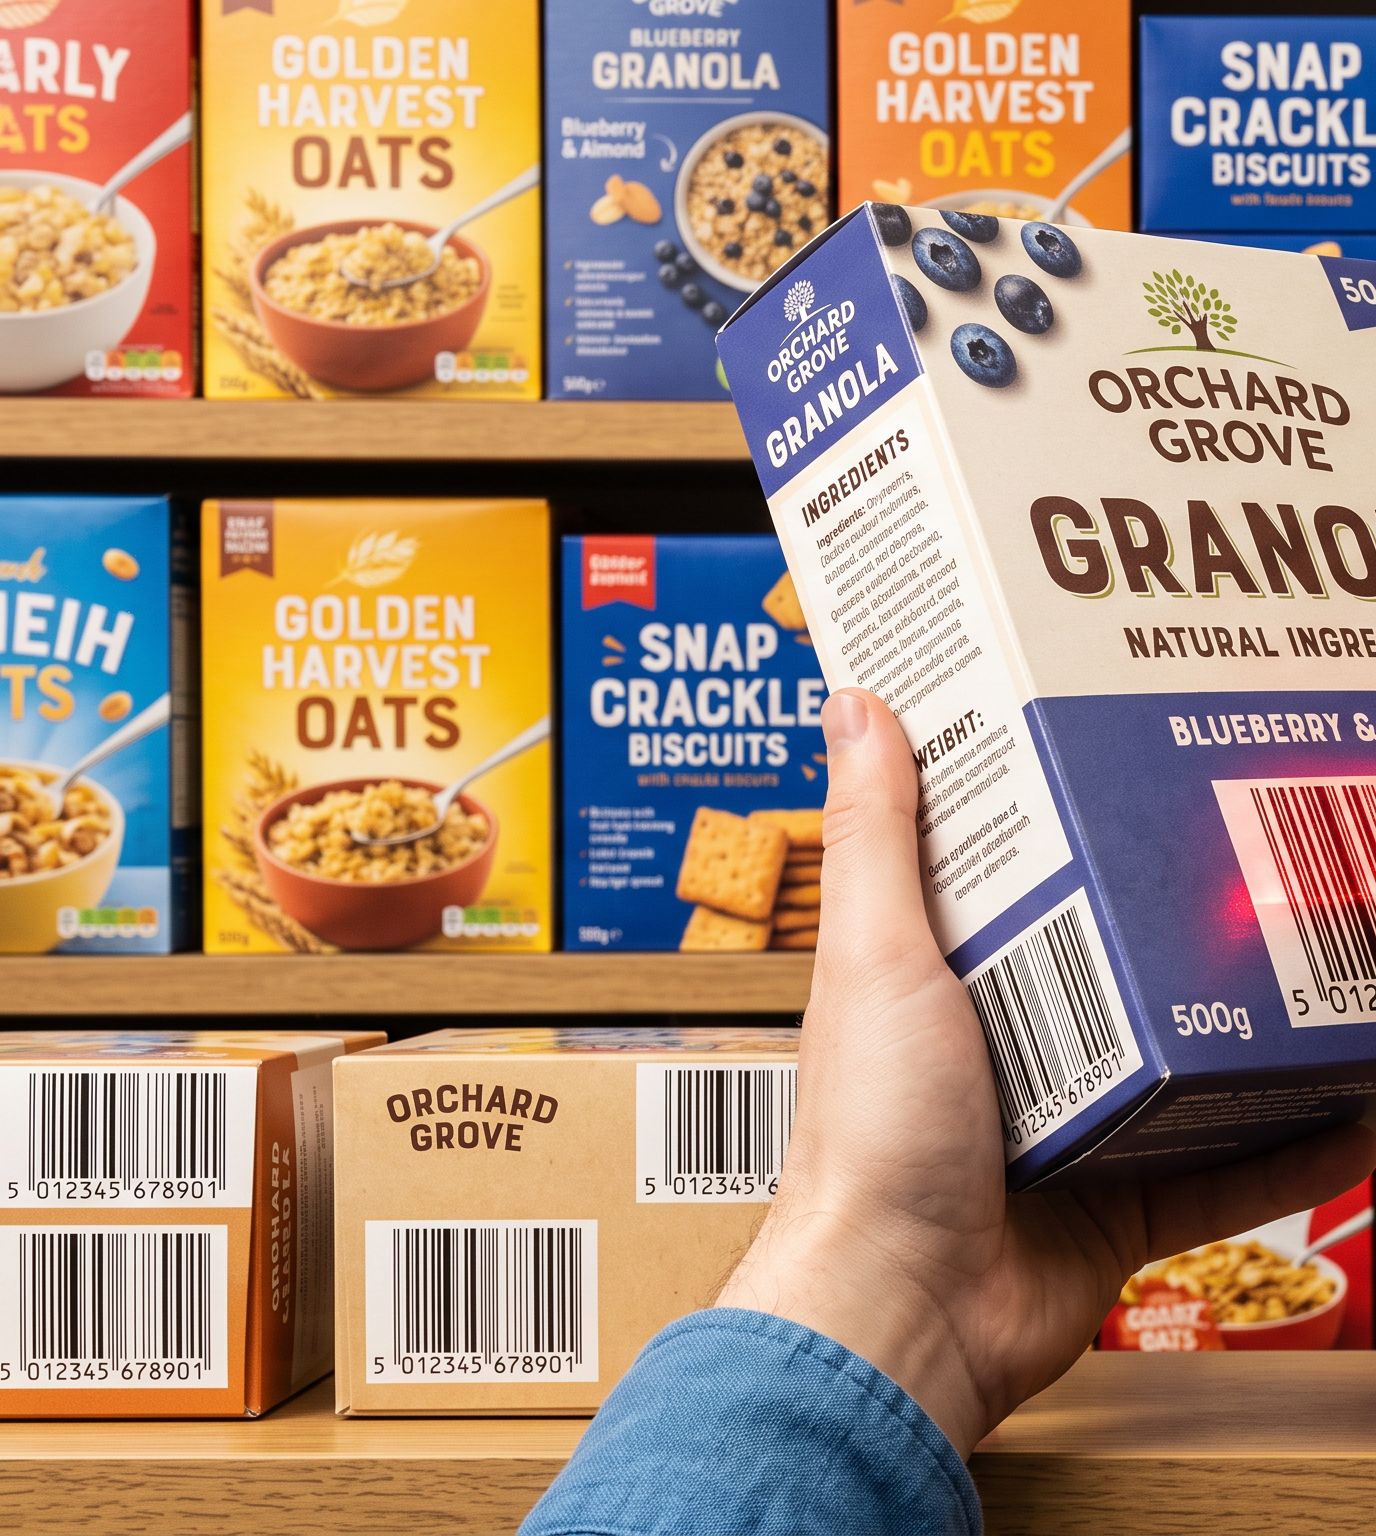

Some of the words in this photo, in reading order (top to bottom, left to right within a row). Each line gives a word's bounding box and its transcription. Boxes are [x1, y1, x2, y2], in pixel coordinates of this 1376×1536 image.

[272, 35, 470, 80] GOLDEN
[630, 28, 741, 47] BLUEBERRY
[888, 32, 1080, 76] GOLDEN
[592, 51, 780, 90] GRANOLA
[1221, 40, 1362, 91] SNAP
[258, 83, 485, 128] HARVEST
[876, 79, 1095, 124] HARVEST
[562, 118, 646, 141] Blueberry
[562, 142, 576, 158] &
[580, 140, 645, 158] Almond
[292, 135, 455, 189] OATS
[919, 128, 1057, 178] OATS
[1212, 153, 1371, 187] BISCUITS
[767, 300, 856, 383] ORCHARD
[786, 328, 850, 393] GROVE
[766, 342, 899, 469] GRANOLA
[1088, 365, 1351, 427] ORCHARD
[1148, 418, 1334, 473] GROVE
[801, 428, 910, 528] INGREDIENTS
[274, 594, 476, 641] GOLDEN
[638, 622, 779, 673] SNAP
[1123, 626, 1279, 659] NATURAL
[261, 644, 491, 690] HARVEST
[295, 694, 462, 751] OATS
[590, 678, 826, 728] CRACKLE
[628, 732, 790, 767] BISCUITS
[1168, 712, 1341, 747] BLUEBERRY
[1173, 1000, 1253, 1040] 500g
[1292, 988, 1310, 1016] 5
[386, 1083, 559, 1124] ORCHARD
[1011, 1094, 1063, 1146] 012345
[1068, 1051, 1123, 1105] 678901
[410, 1121, 525, 1152] GROVE
[8, 1181, 19, 1199] 5
[37, 1180, 121, 1200] 012345
[134, 1180, 218, 1200] 678901
[645, 1177, 656, 1196] 5
[673, 1176, 755, 1196] 012345
[0, 1362, 11, 1381] 5
[27, 1361, 109, 1381] 012345
[121, 1361, 202, 1381] 678901
[374, 1356, 385, 1375] 5
[401, 1356, 482, 1375] 012345
[493, 1356, 575, 1375] 678901
